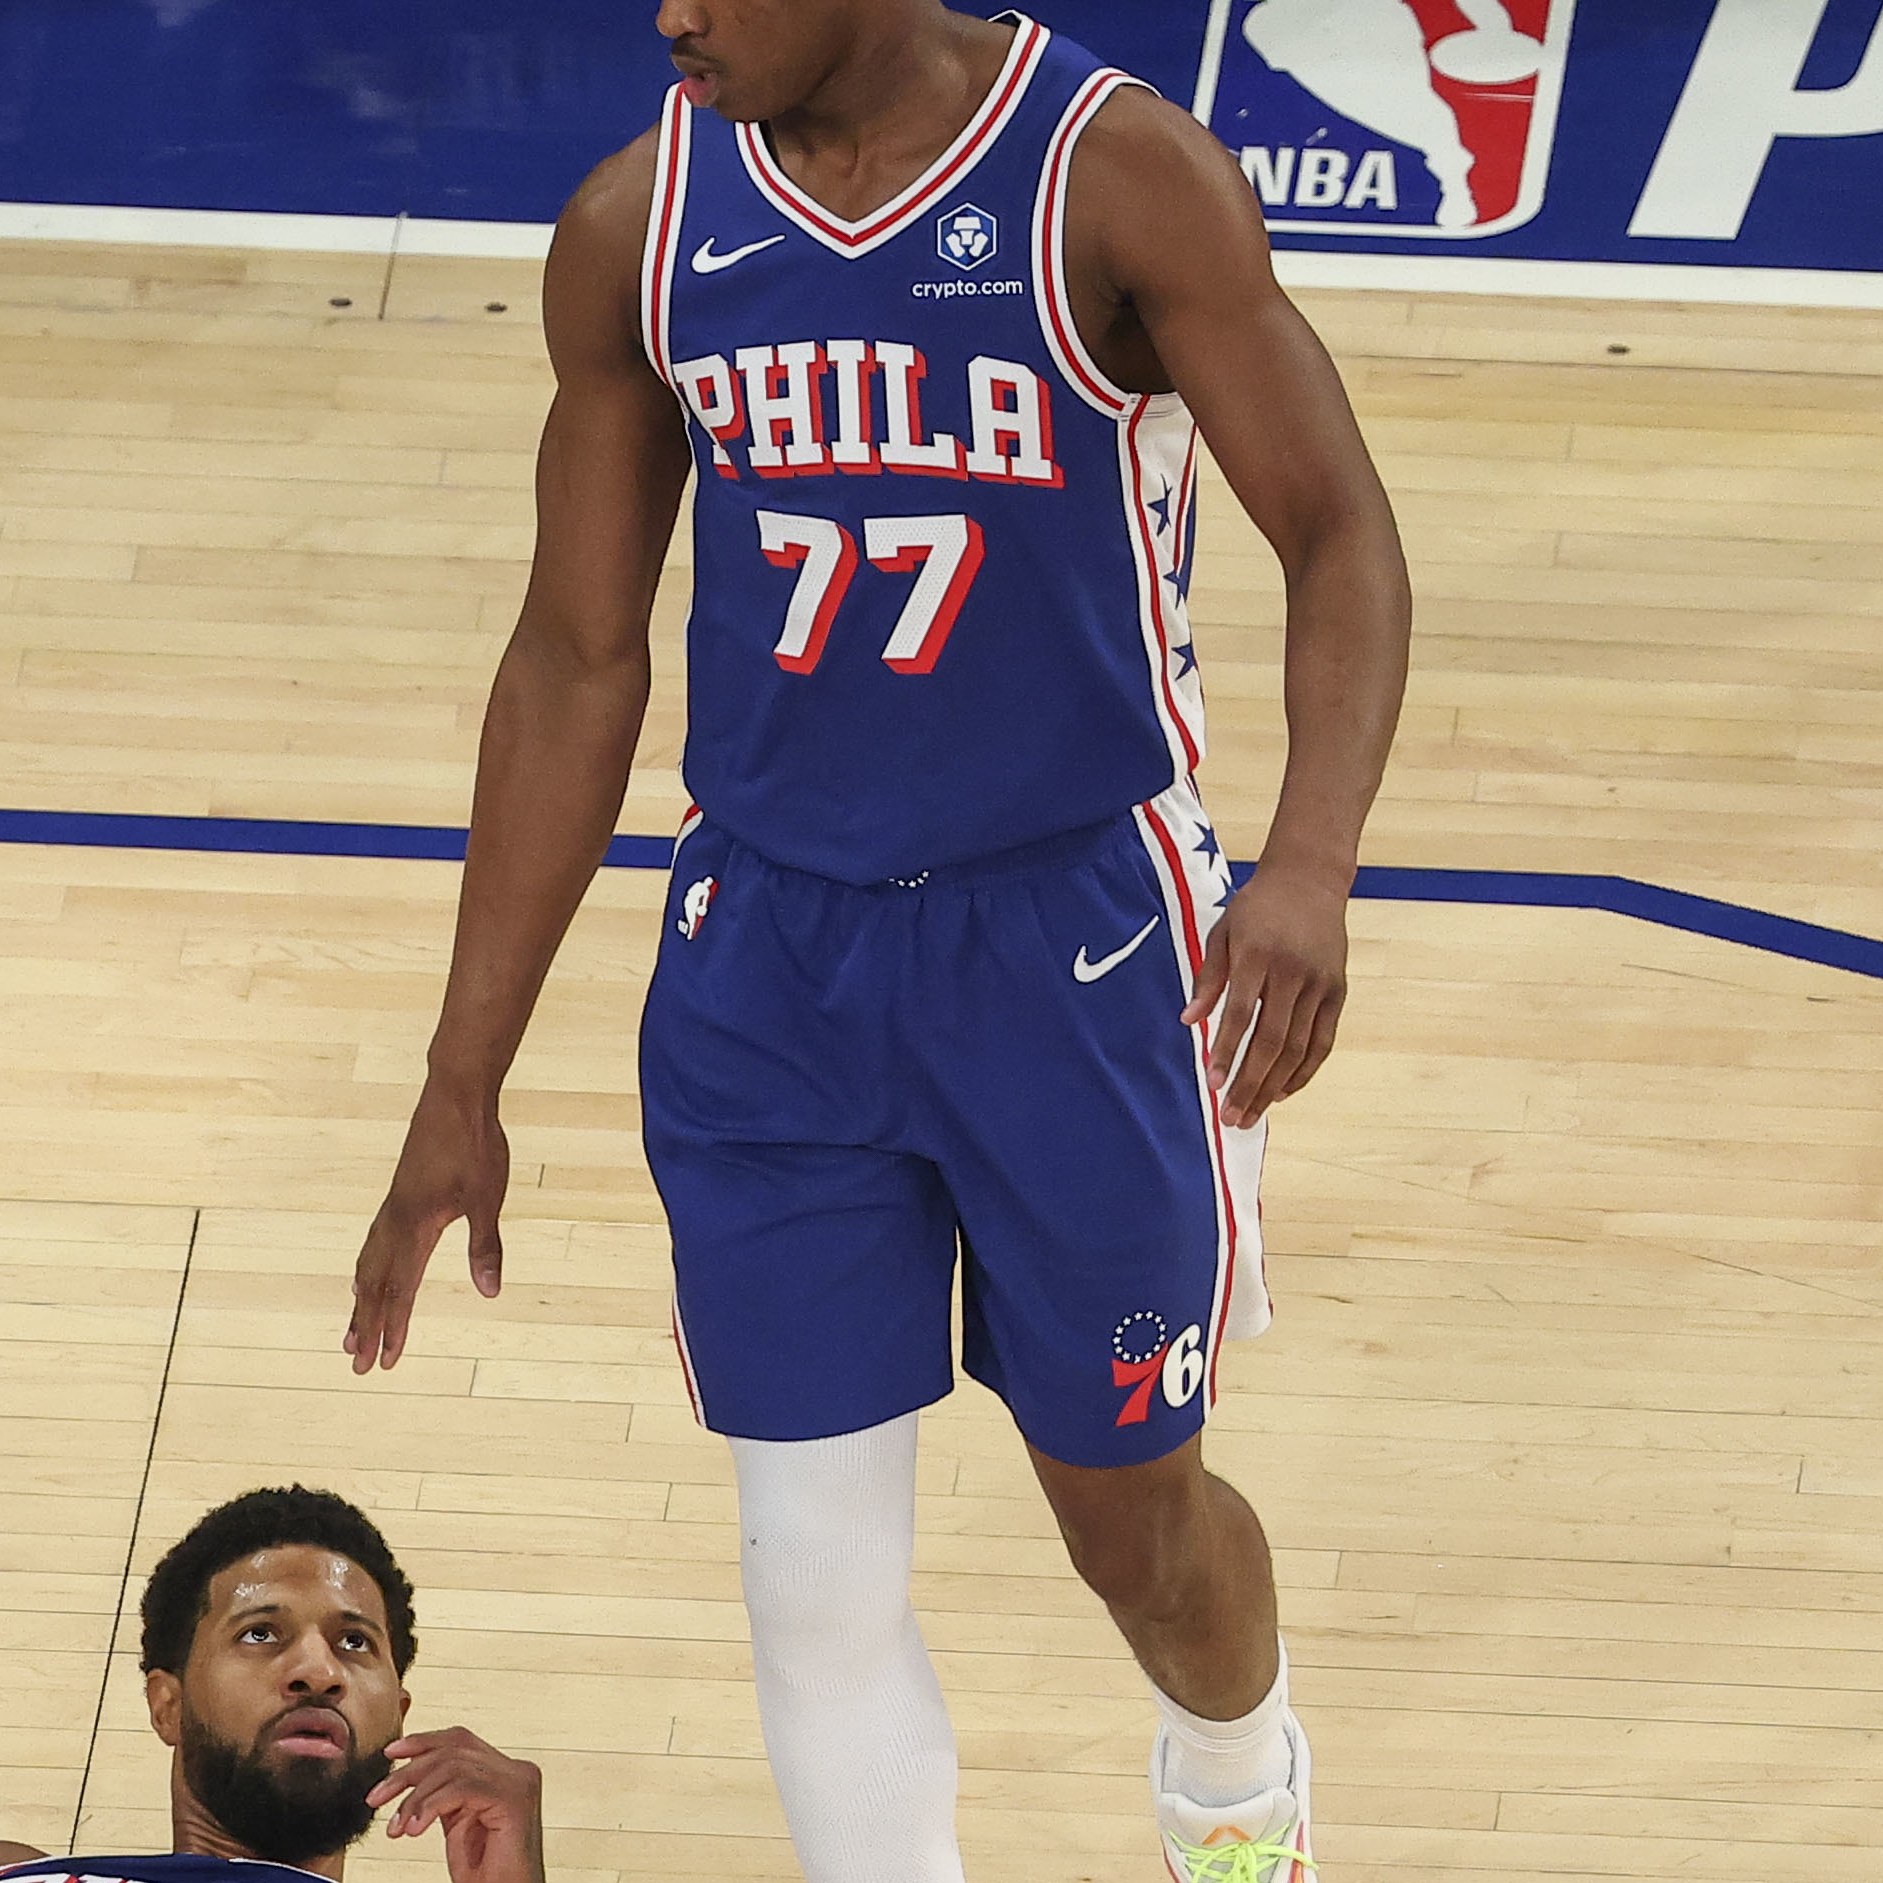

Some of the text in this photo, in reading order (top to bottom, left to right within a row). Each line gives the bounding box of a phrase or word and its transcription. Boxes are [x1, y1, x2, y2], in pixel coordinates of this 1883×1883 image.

[1240, 146, 1398, 210] NBA
[912, 278, 1023, 298] crypto.com
[673, 340, 1065, 488] PHILA
[756, 509, 986, 675] 77
[1111, 1323, 1205, 1427] 76
